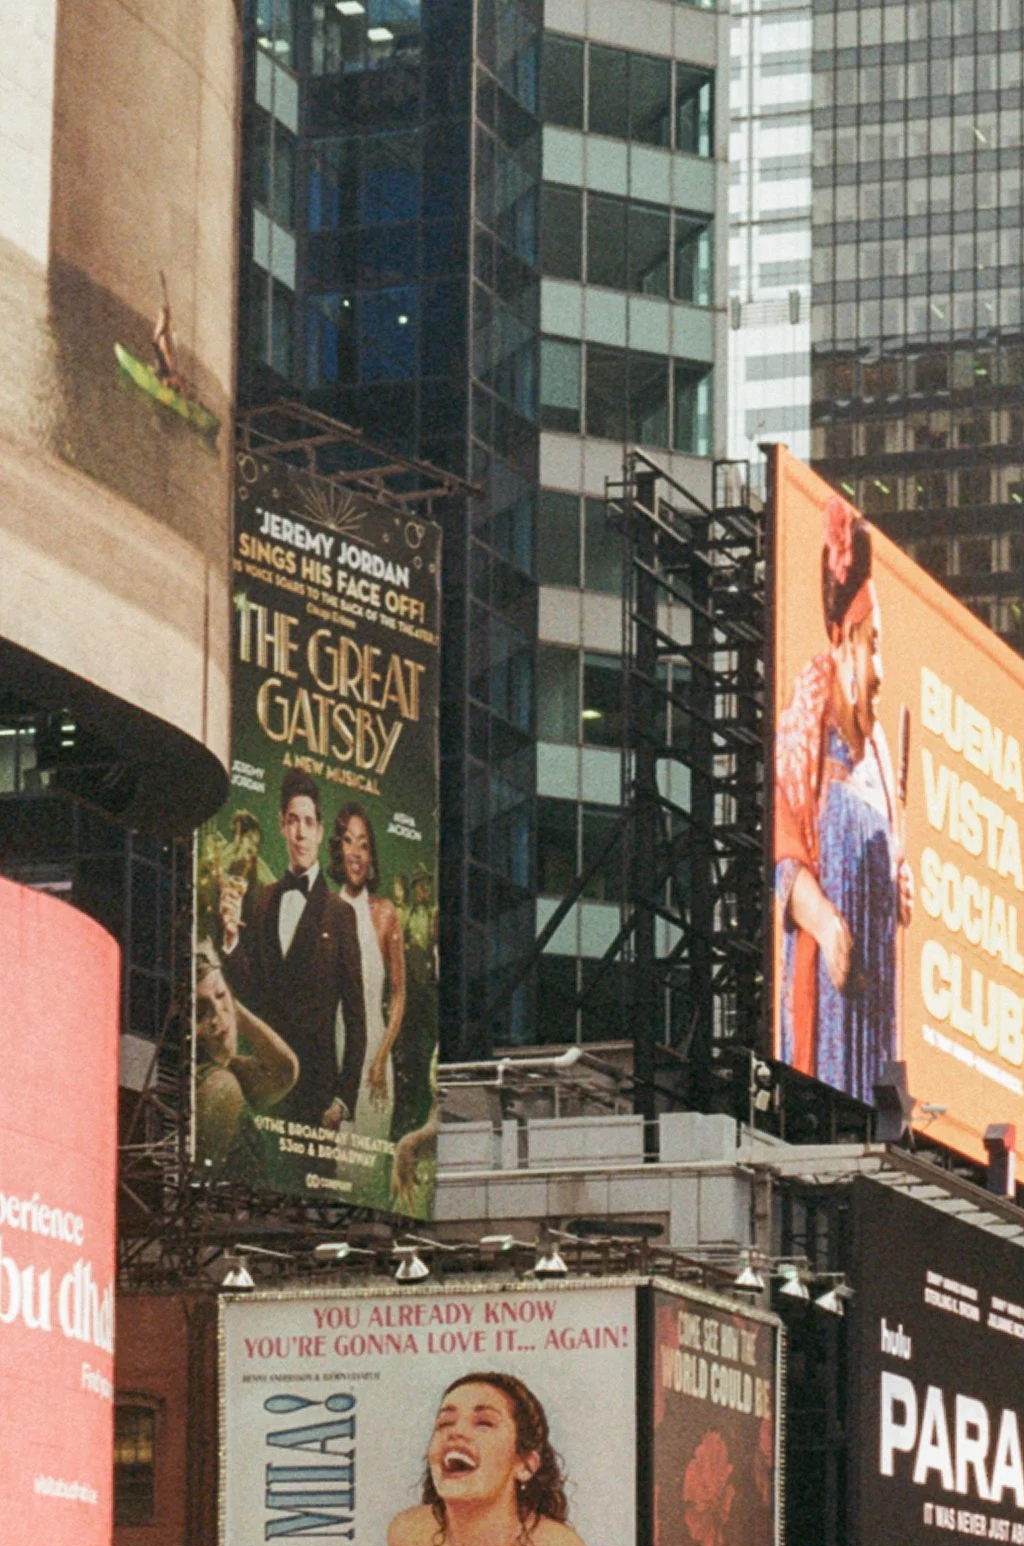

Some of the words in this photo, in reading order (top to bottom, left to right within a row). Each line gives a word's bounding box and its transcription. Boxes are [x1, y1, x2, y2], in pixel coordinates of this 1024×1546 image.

[239, 532, 297, 575] SINGS
[301, 556, 333, 589] HIS
[336, 570, 381, 607] FACE
[385, 590, 425, 624] OFF!
[337, 541, 410, 589] JORDAN
[239, 602, 299, 680] THE
[307, 628, 426, 722] GREAT
[257, 677, 403, 776] GATSBY
[921, 666, 1024, 803] BUENA
[921, 747, 1024, 891] VISTA
[921, 847, 1024, 975] SOCIAL
[245, 1335, 326, 1359] YOU'RE
[335, 1332, 420, 1357] GONNA
[427, 1330, 487, 1354] LOVE
[496, 1328, 537, 1353] IT...
[545, 1325, 629, 1350] AGAIN!
[313, 1307, 362, 1329] YOU
[368, 1302, 475, 1327] ALREADY
[485, 1299, 558, 1323] KNOW
[703, 1318, 719, 1357] SEE
[881, 1317, 911, 1360] hulu
[661, 1344, 708, 1399] WORLD
[711, 1361, 752, 1415] COULD
[755, 1376, 772, 1420] BE
[262, 1392, 357, 1542] MIA!
[923, 1503, 934, 1525] IT
[935, 1505, 955, 1531] WAS
[957, 1509, 987, 1537] NEVER
[988, 1517, 1010, 1542] JUST
